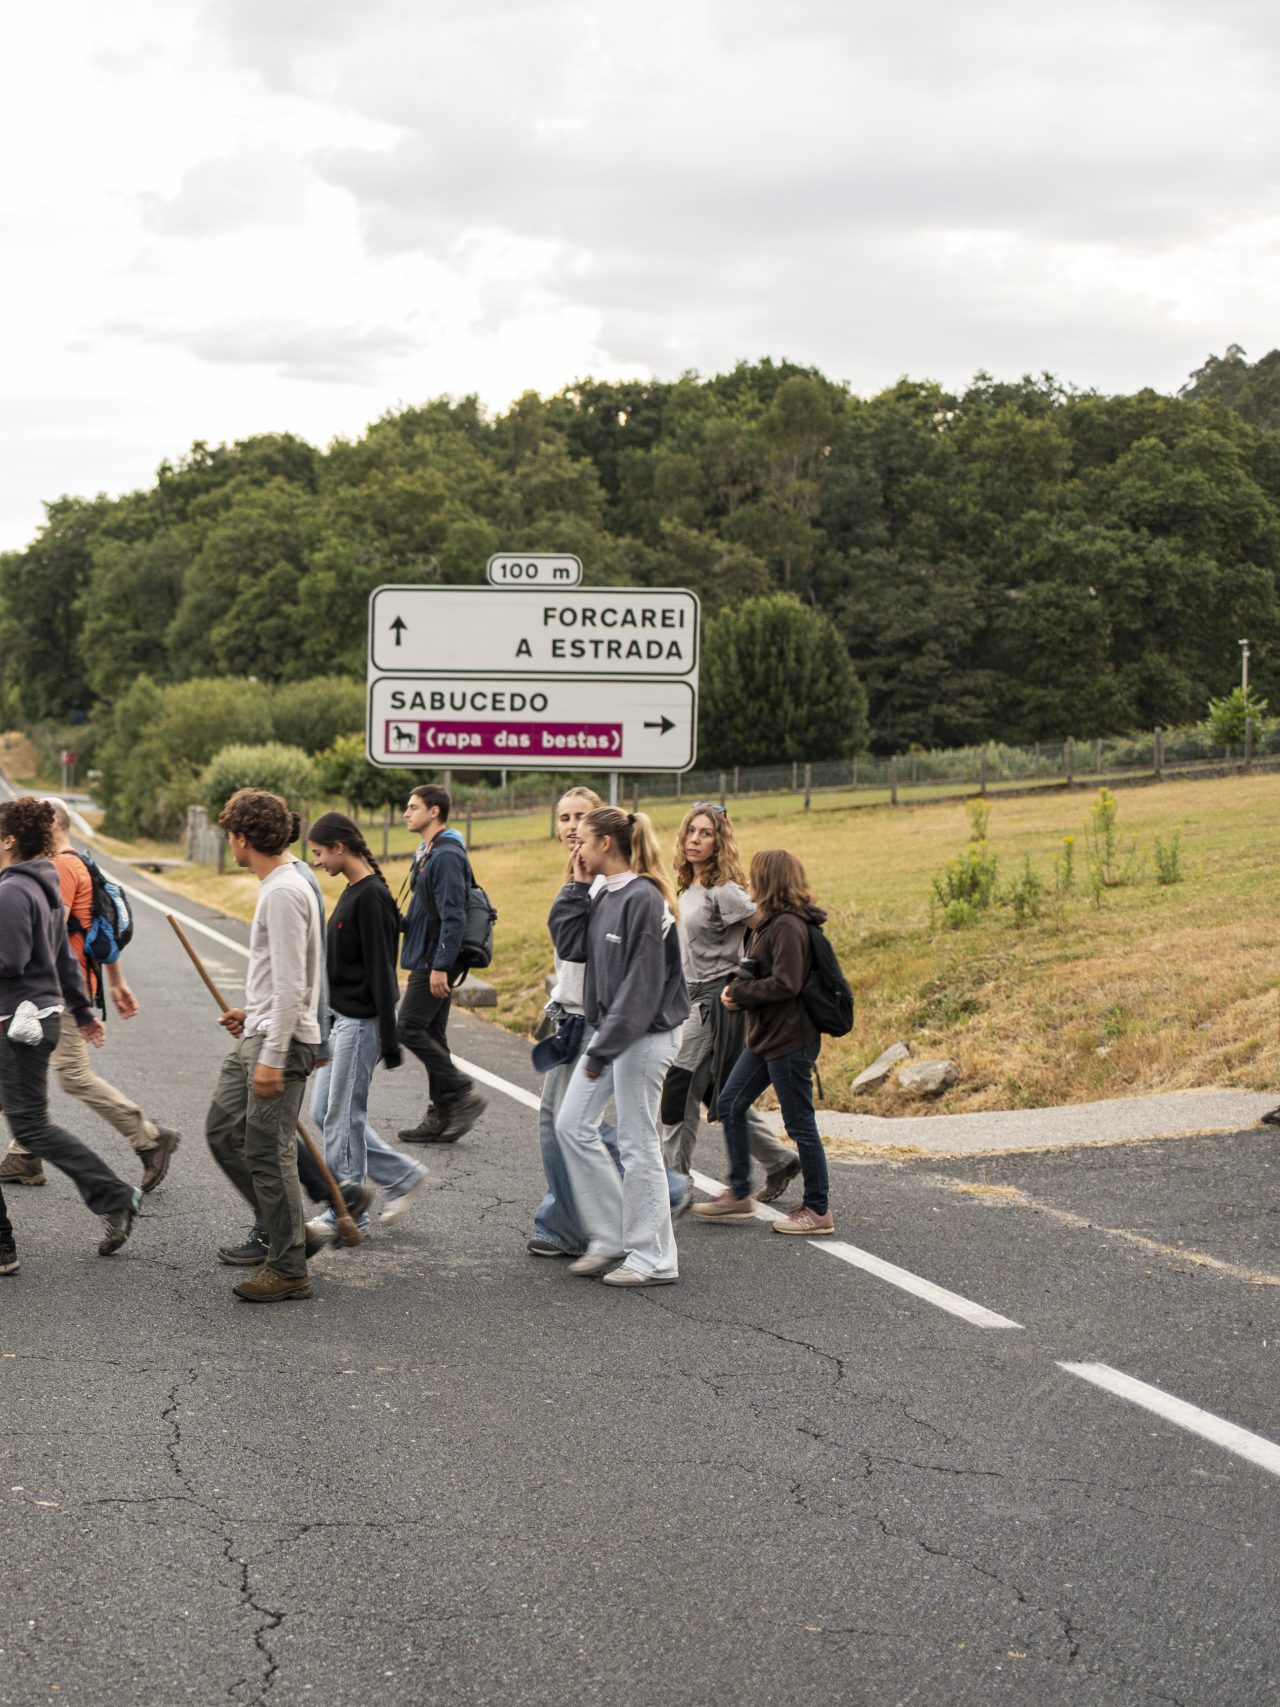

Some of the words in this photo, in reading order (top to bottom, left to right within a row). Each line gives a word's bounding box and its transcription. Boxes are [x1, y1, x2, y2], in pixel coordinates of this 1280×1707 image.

[500, 563, 539, 580] 100
[552, 567, 570, 580] m
[543, 607, 685, 629] FORCAREI
[515, 638, 533, 658] A
[552, 639, 683, 660] ESTRADA
[390, 691, 549, 712] SABUCEDO
[426, 727, 482, 749] (rapa
[494, 730, 531, 747] das
[542, 731, 621, 751] bestas)
